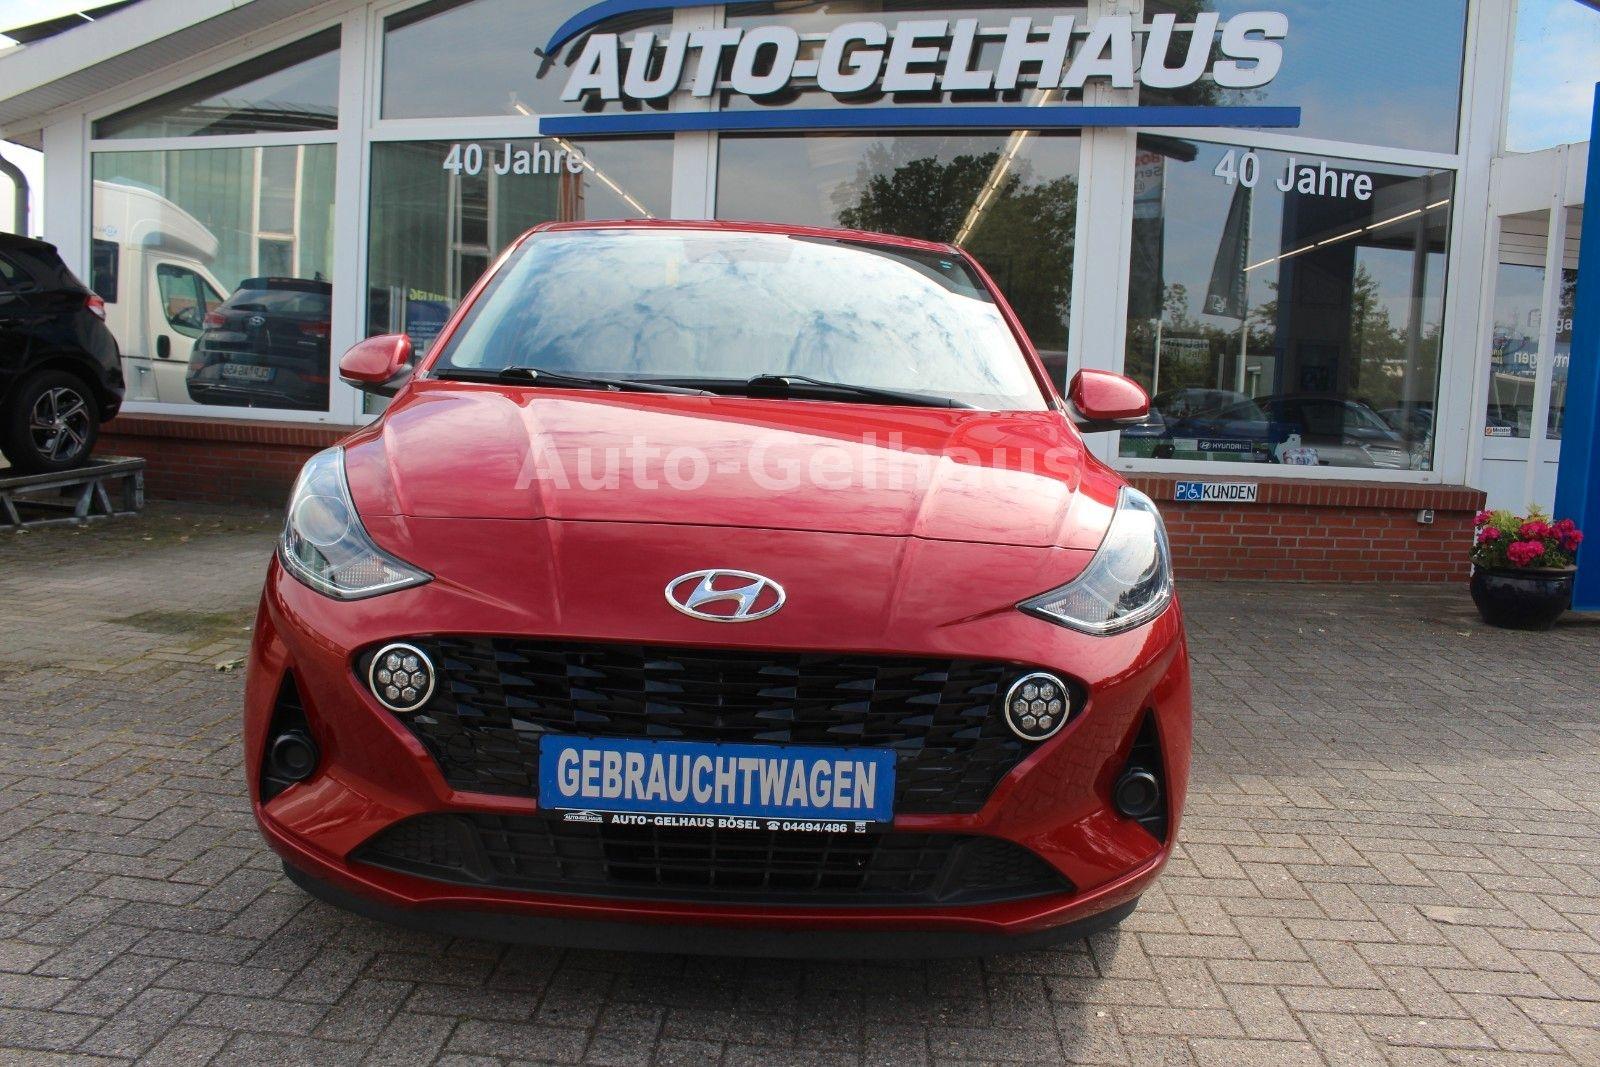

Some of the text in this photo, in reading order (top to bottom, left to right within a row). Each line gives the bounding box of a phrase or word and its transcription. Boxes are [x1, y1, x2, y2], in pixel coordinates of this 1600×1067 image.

[562, 11, 1289, 103] AUTO-GELHAUS
[443, 142, 584, 176] 40 Jahre
[1213, 149, 1374, 201] 40 Jahre
[1203, 485, 1256, 499] KUNDEN
[557, 748, 877, 809] GEBRAUCHTWAGEN
[611, 814, 848, 833] AUTO-GELHAUS BÖSEL 04494/486
